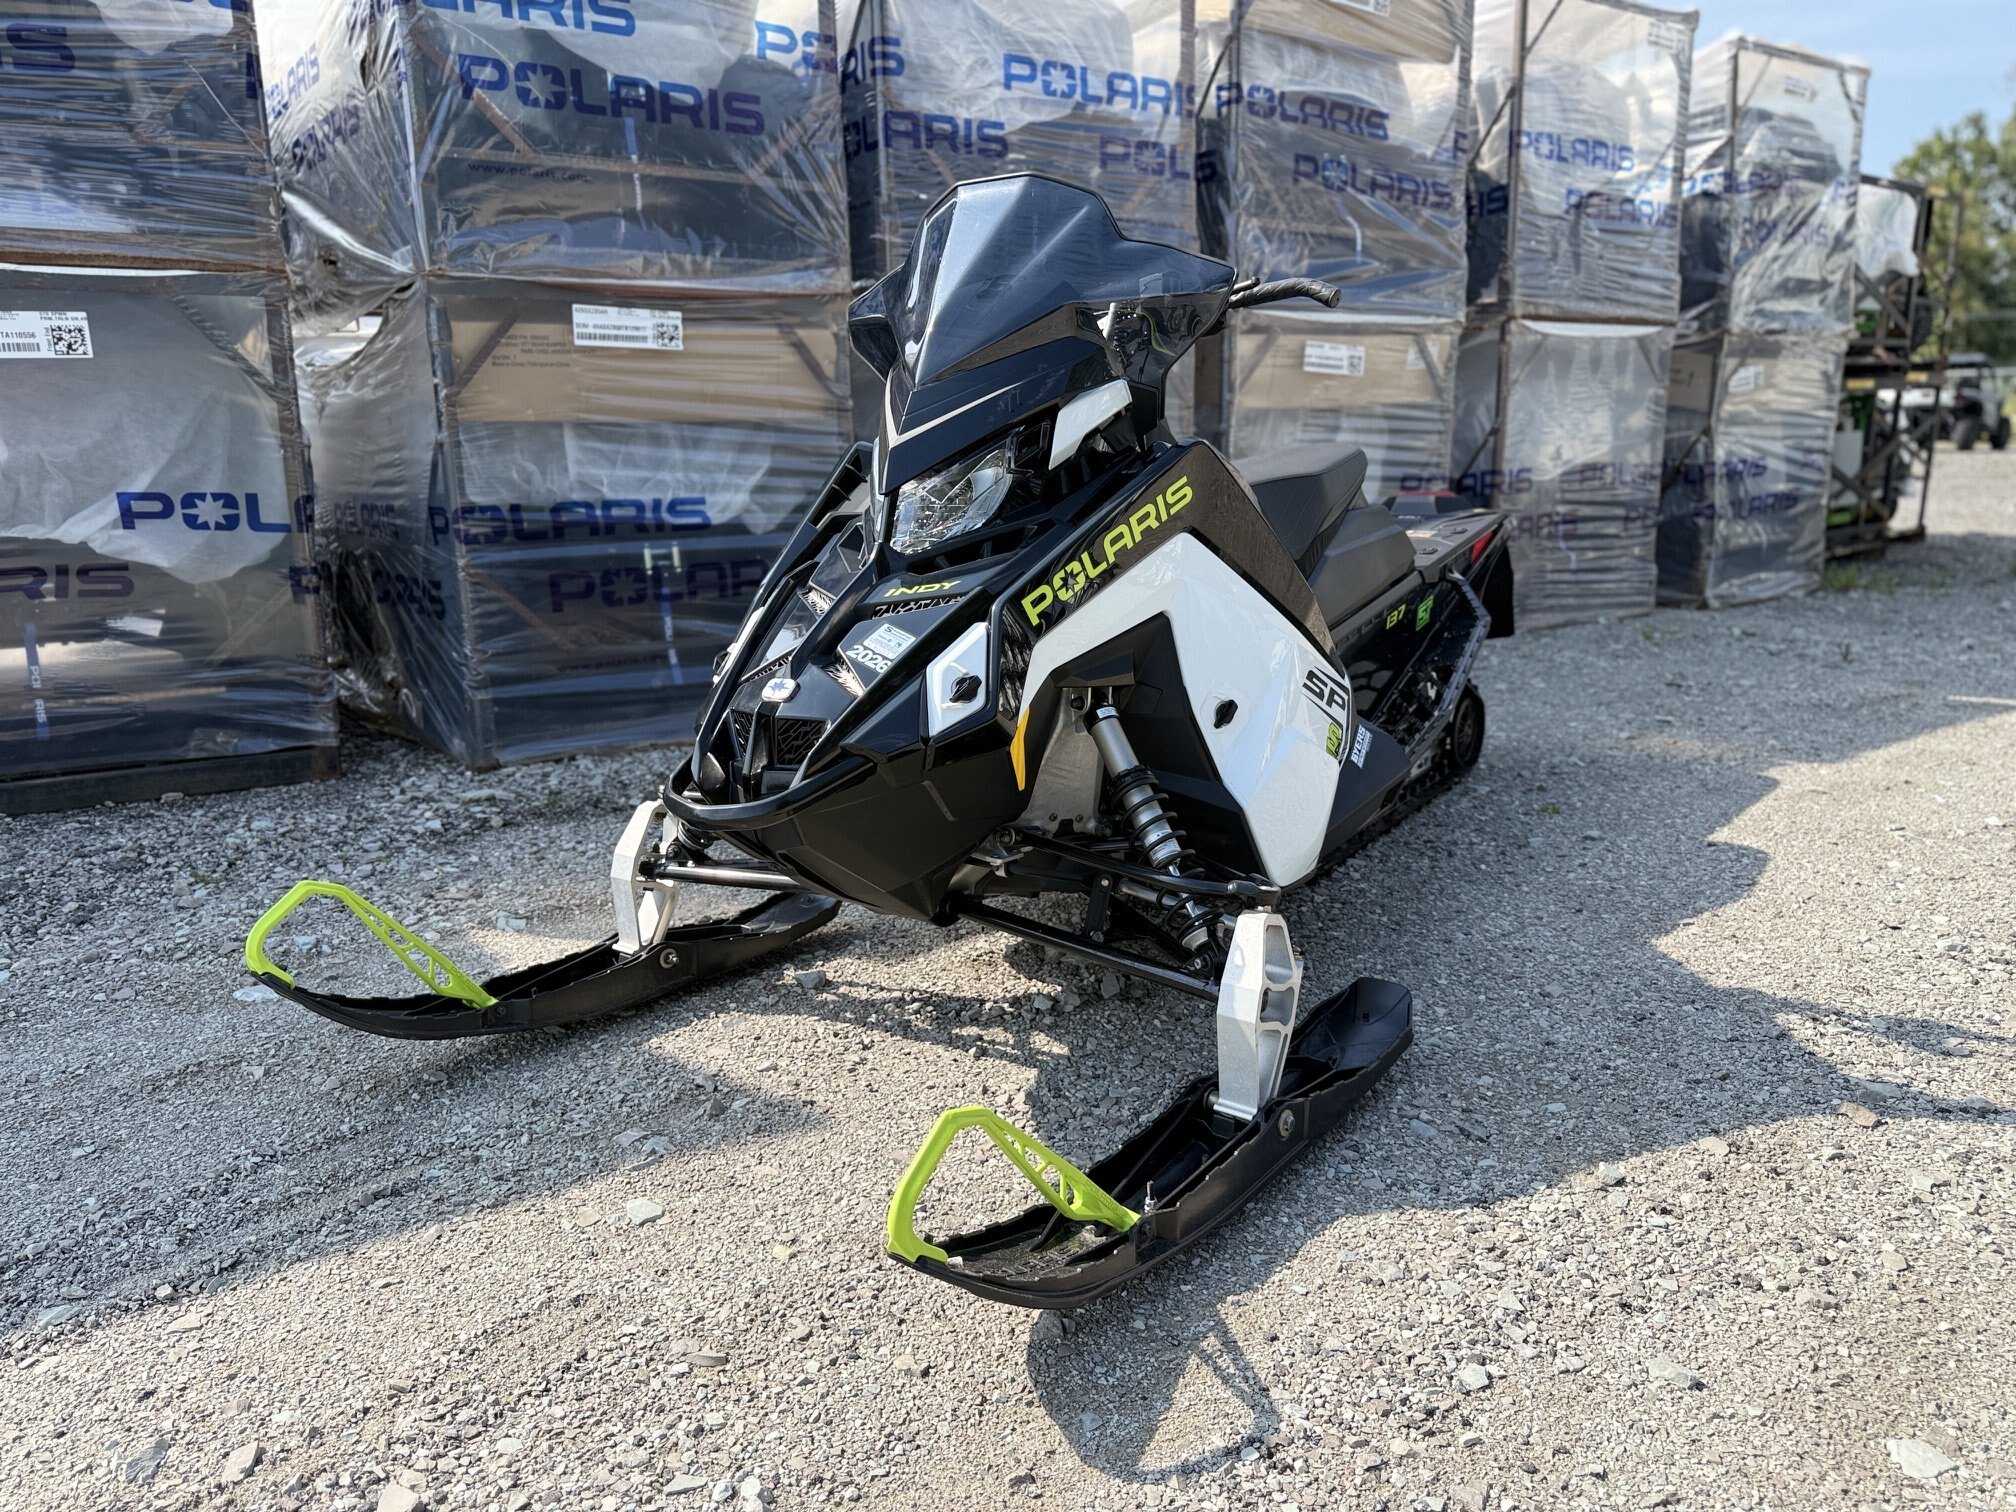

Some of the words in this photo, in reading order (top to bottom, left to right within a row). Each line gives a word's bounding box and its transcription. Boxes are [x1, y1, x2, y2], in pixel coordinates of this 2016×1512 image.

[458, 53, 766, 137] POLARIS
[1216, 81, 1389, 141] POLARIS
[1509, 129, 1635, 172] POLARIS
[1293, 152, 1453, 212] POLARIS
[429, 495, 706, 546] POLARIS
[1021, 475, 1194, 626] POLARIS
[883, 580, 962, 597] INDY
[1385, 603, 1406, 630] 137
[845, 644, 892, 674] 2026
[1302, 668, 1346, 712] SP
[1350, 724, 1366, 765] BYERS
